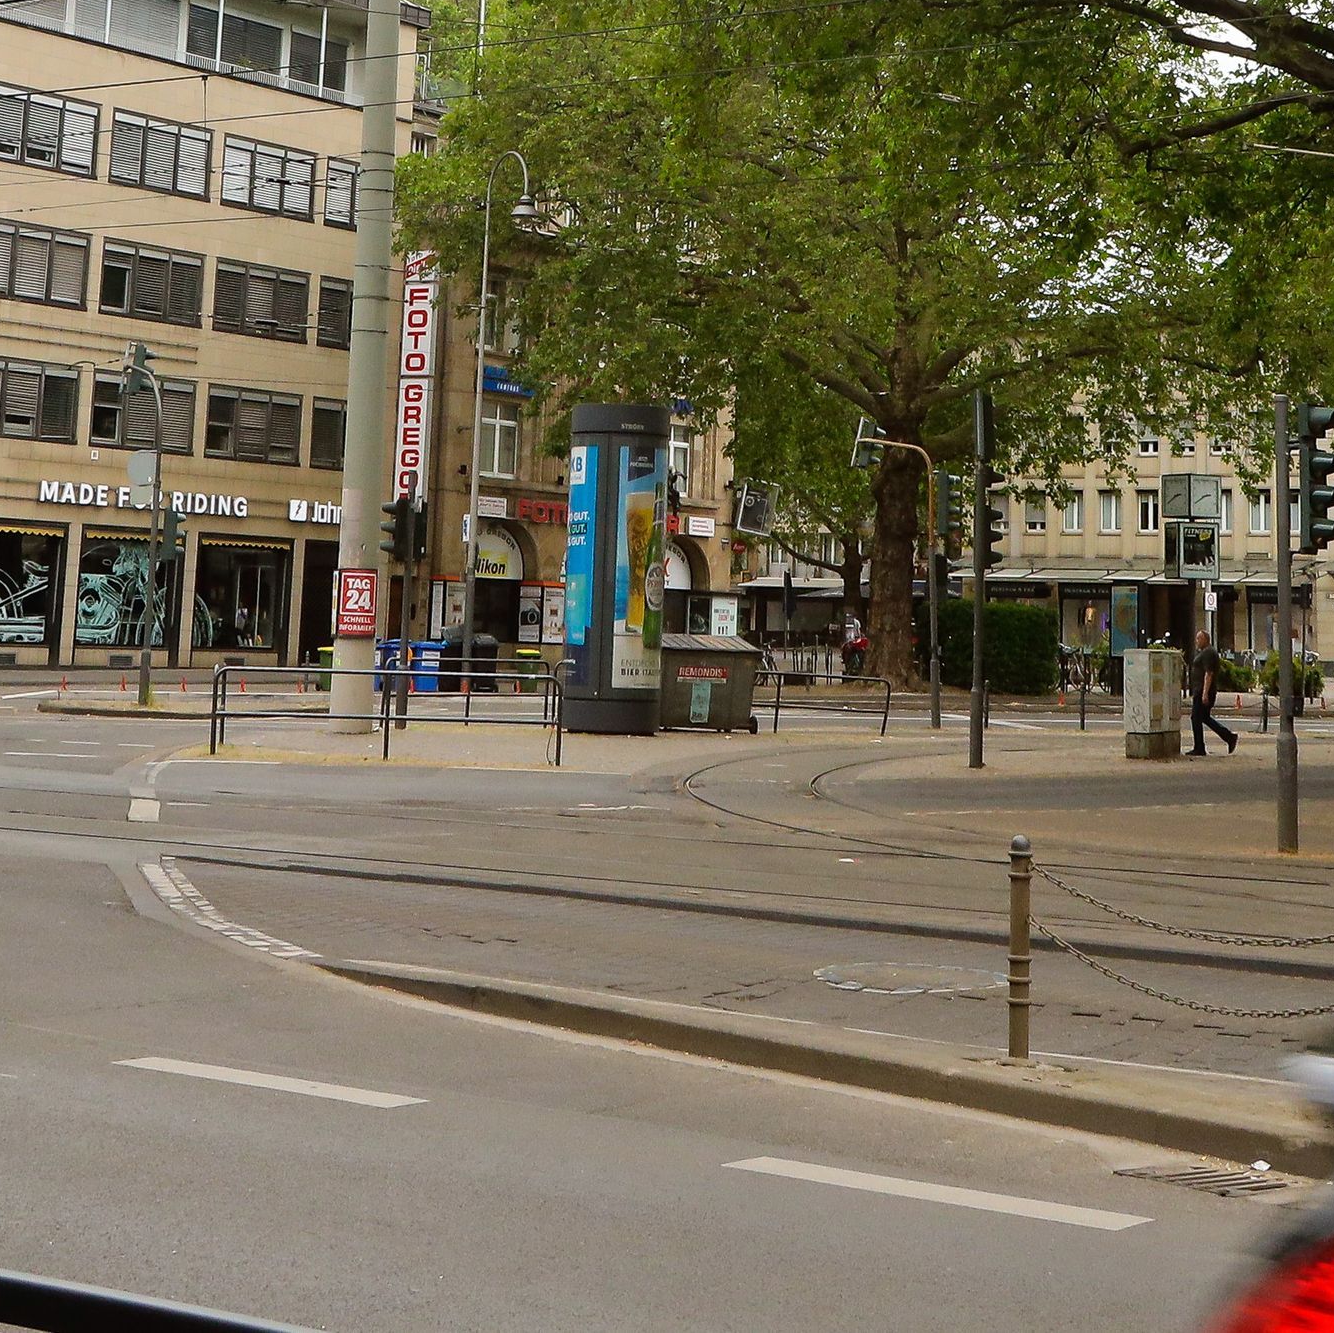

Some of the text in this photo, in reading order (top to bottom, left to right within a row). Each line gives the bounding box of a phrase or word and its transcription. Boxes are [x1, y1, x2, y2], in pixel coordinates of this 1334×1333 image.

[405, 288, 429, 372] FOTO
[398, 384, 423, 501] GREGO
[39, 479, 109, 507] MADE
[172, 491, 248, 517] RIDING
[346, 578, 370, 590] TAG
[346, 589, 371, 610] 24
